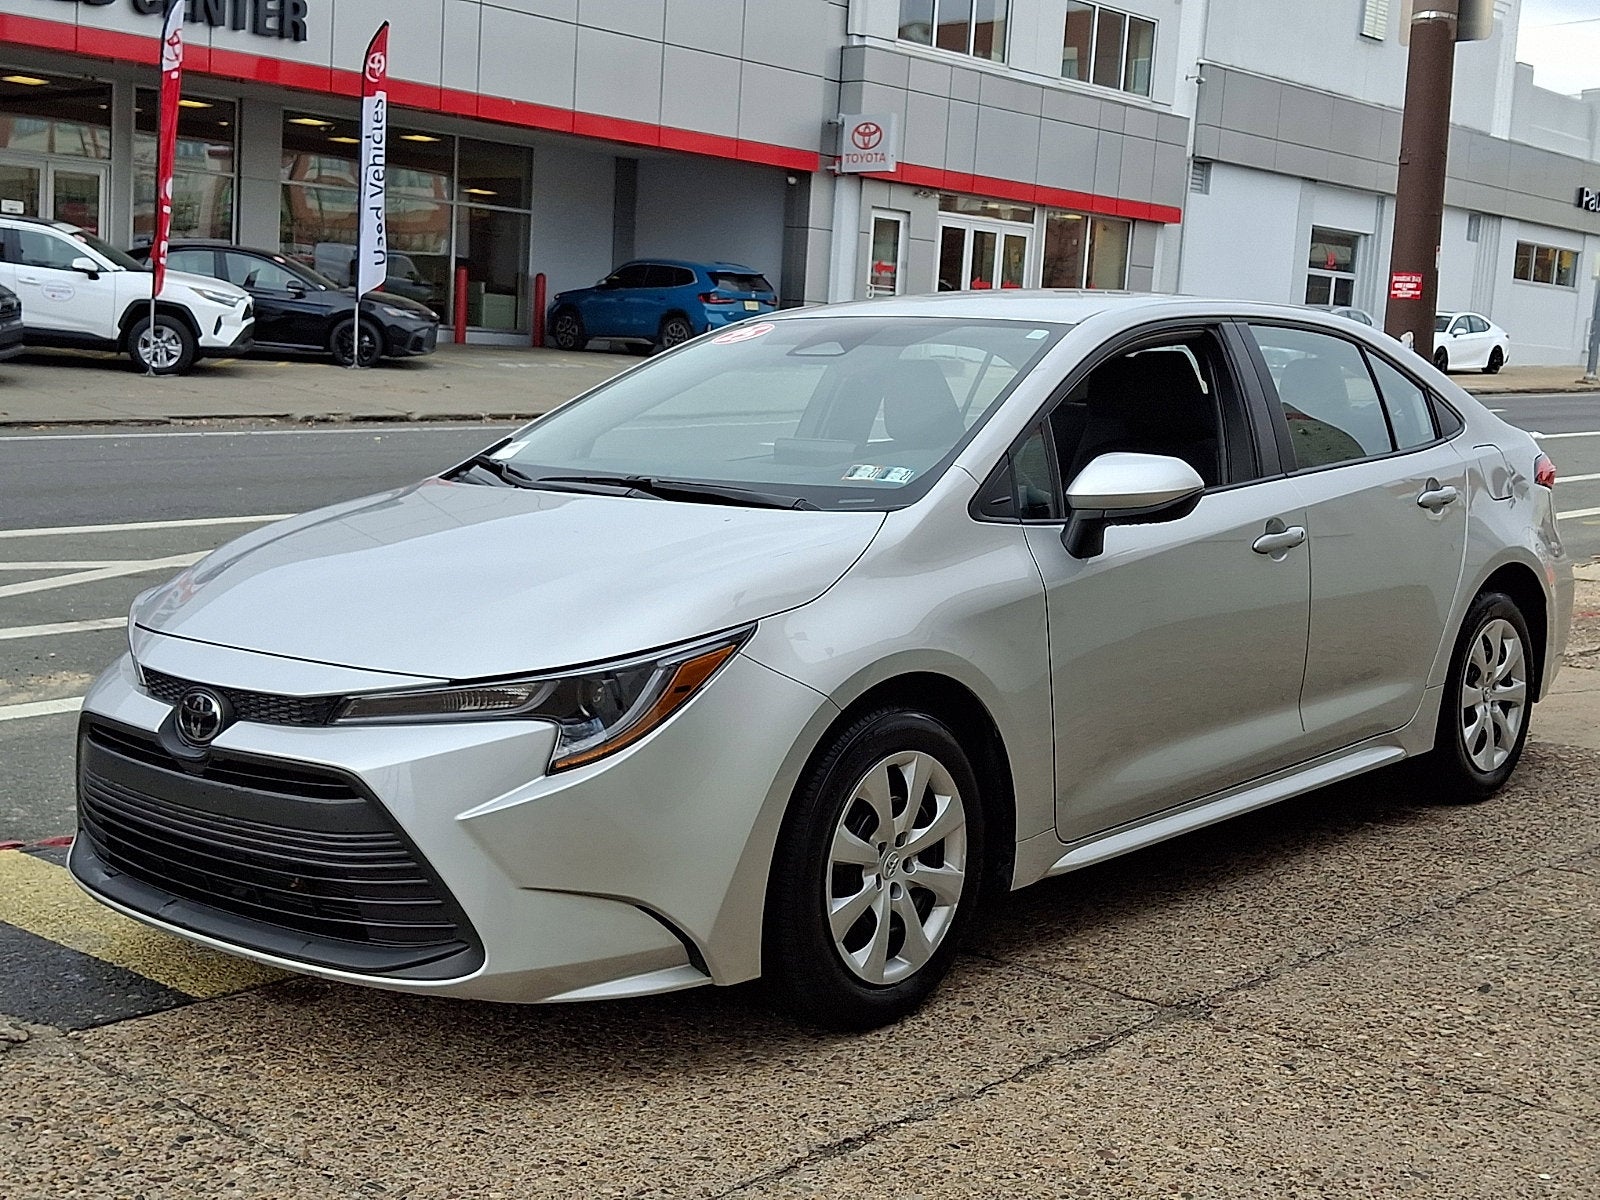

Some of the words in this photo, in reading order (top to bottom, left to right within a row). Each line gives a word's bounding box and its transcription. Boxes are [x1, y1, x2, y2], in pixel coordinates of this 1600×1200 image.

[132, 0, 307, 41] NTER
[365, 97, 386, 200] Vehicles
[845, 152, 886, 164] TOYOTA
